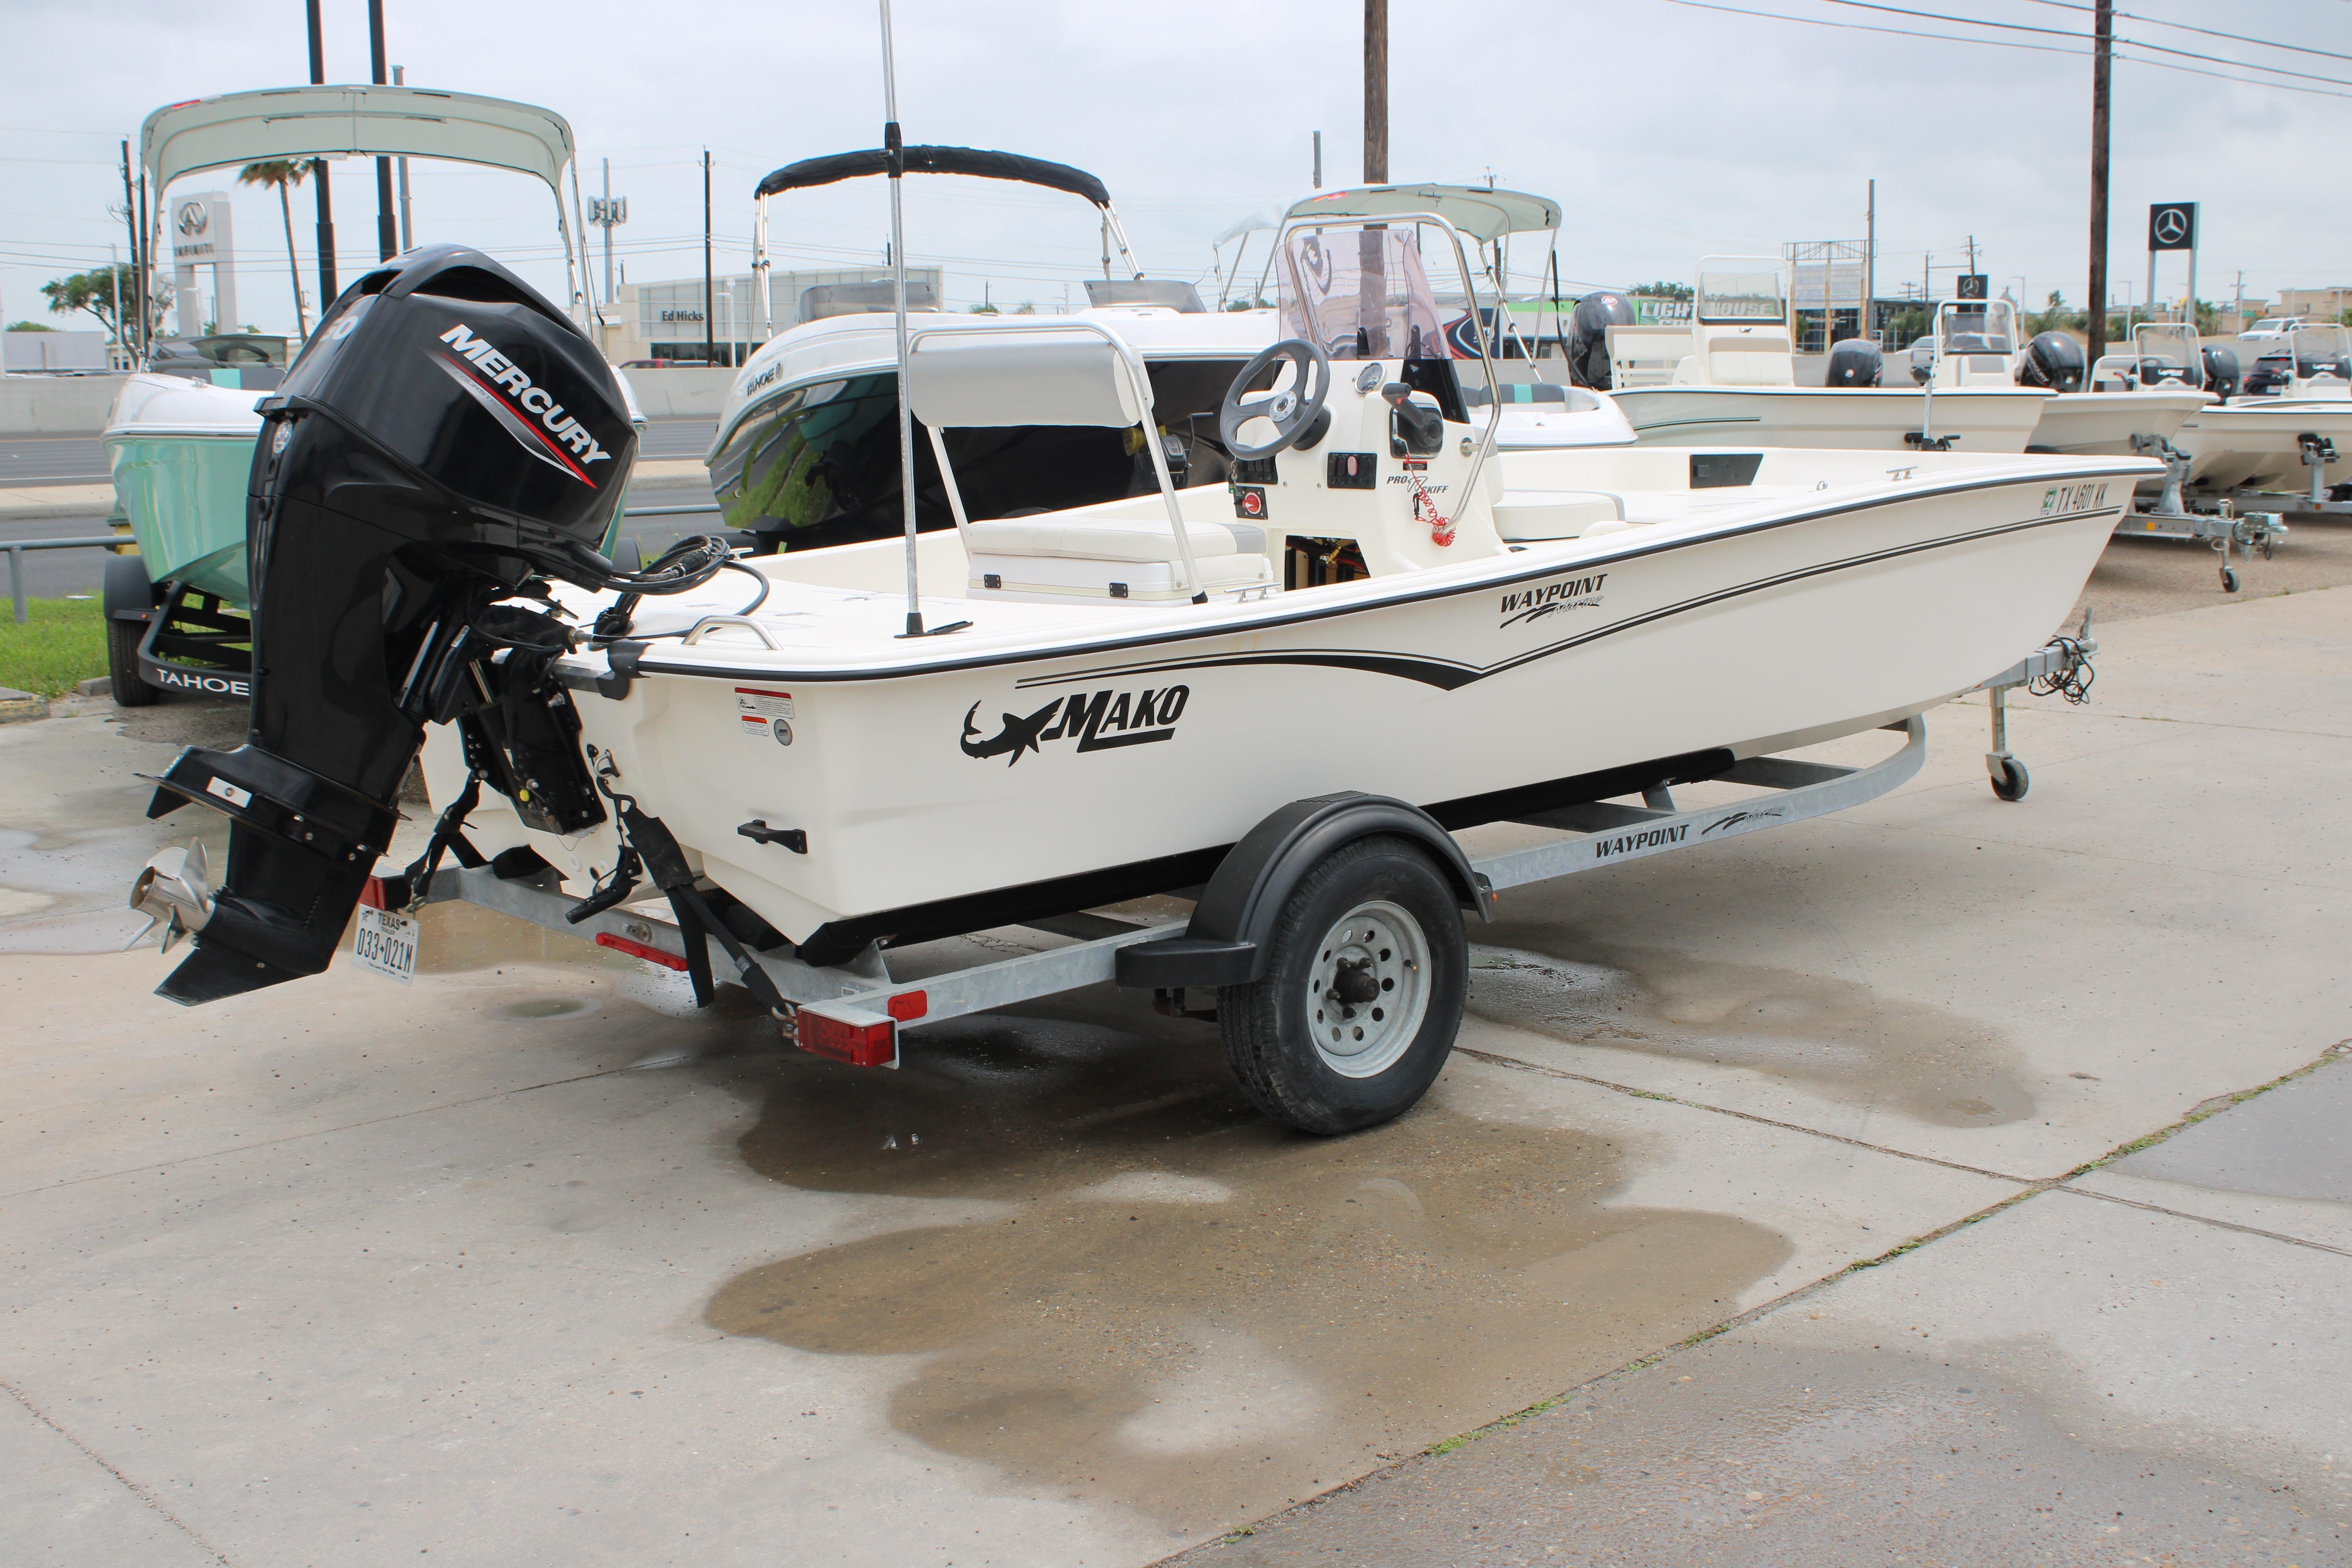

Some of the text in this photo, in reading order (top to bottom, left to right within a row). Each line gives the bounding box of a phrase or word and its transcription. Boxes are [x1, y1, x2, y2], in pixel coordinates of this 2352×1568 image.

[662, 310, 704, 321] Ed Hicks
[439, 323, 612, 464] MERCURY
[453, 370, 514, 419] FOURSTROKE
[747, 367, 775, 397] TAHOE
[1387, 475, 1408, 485] PRO
[1423, 485, 1449, 494] SKIFF
[2056, 486, 2074, 513] TX
[2073, 483, 2095, 510] 4601
[2092, 483, 2109, 509] KK
[1501, 573, 1608, 613] WAYPOINT
[1548, 595, 1604, 618] Marine
[156, 668, 250, 696] TAHOE
[1040, 684, 1190, 753] MAKO
[1596, 806, 1786, 858] WAYPOINT Marine
[378, 913, 400, 931] TEXAS
[380, 926, 395, 935] TRAILER
